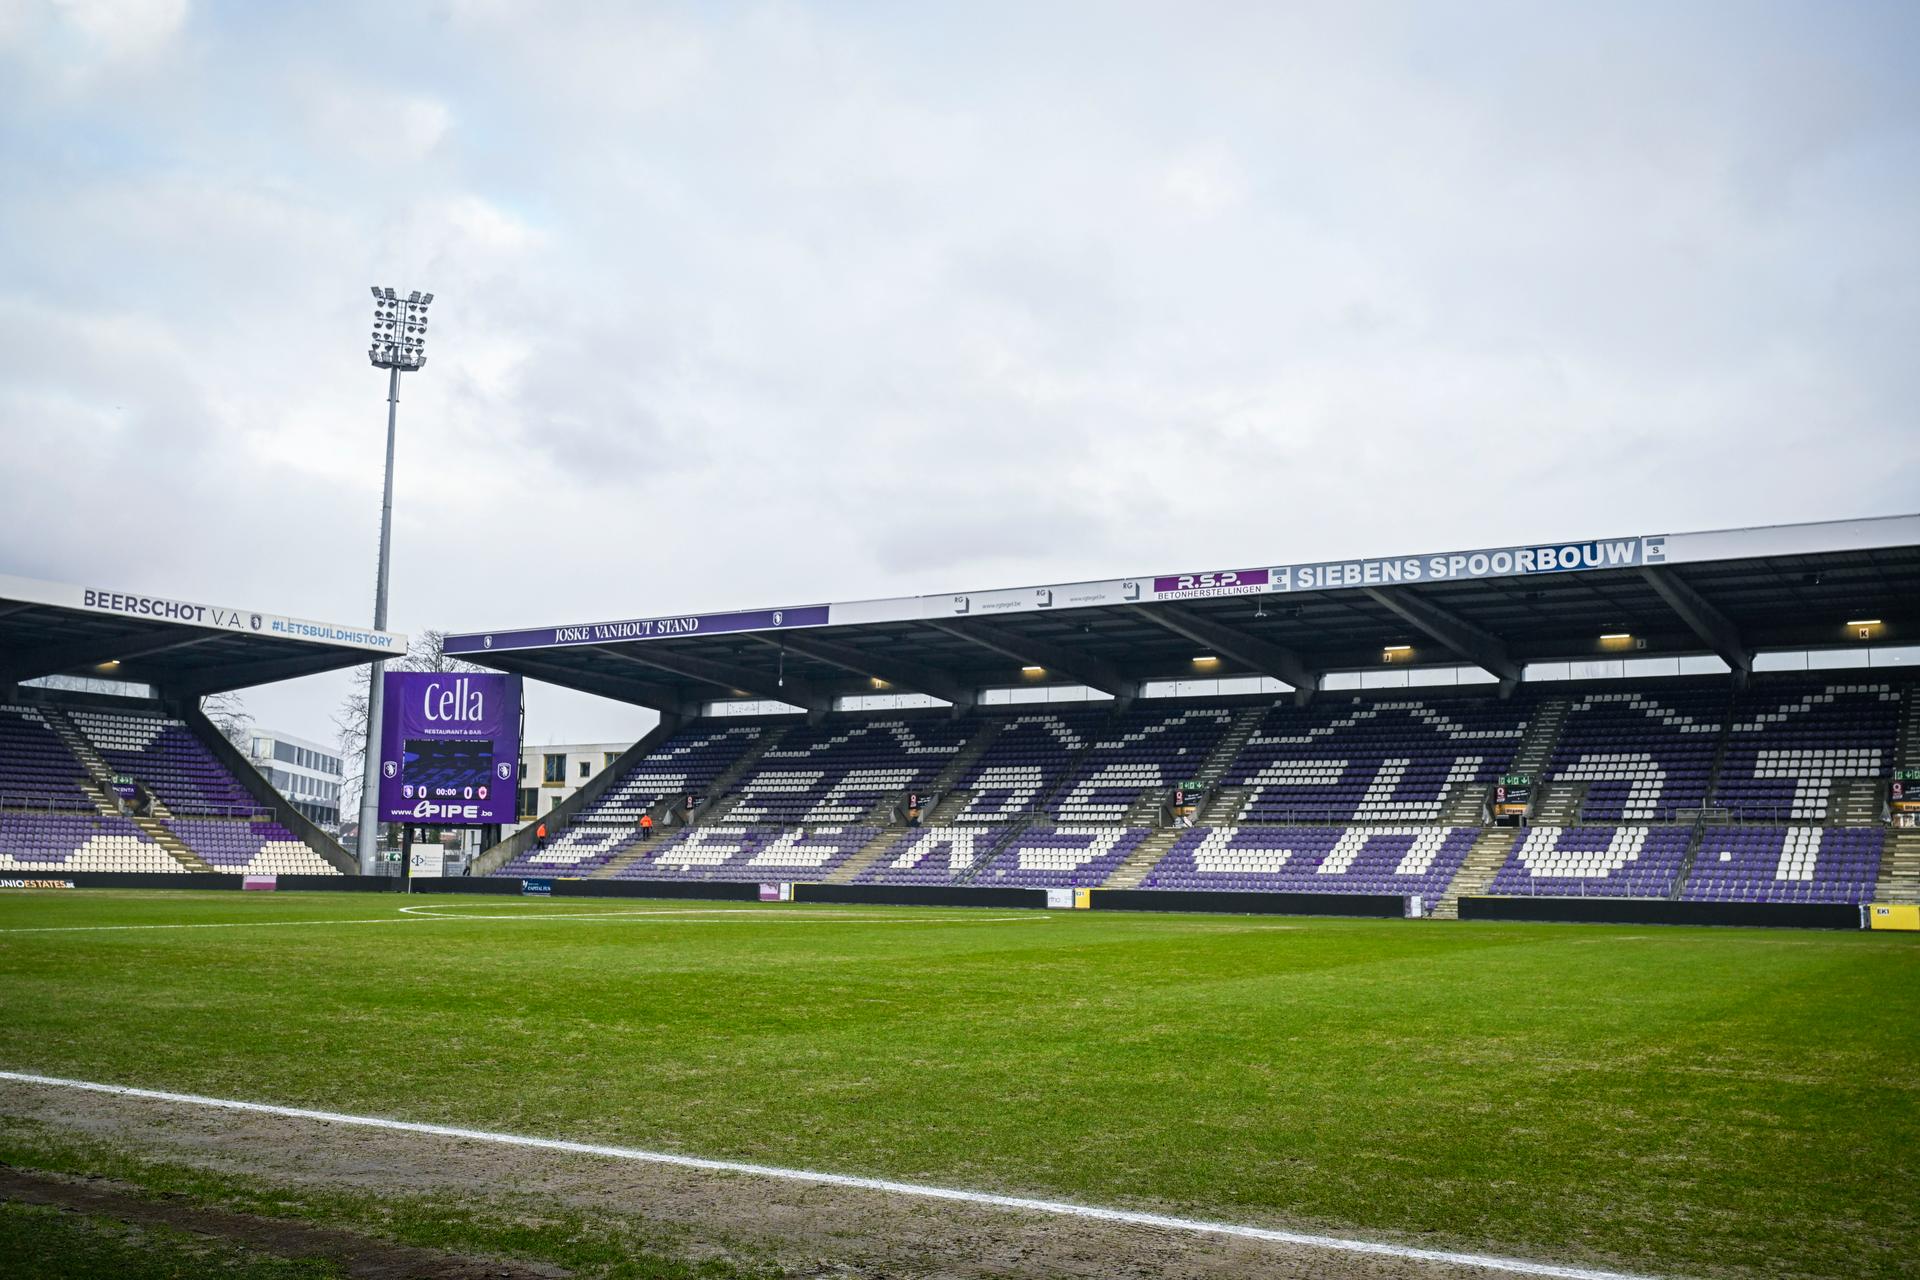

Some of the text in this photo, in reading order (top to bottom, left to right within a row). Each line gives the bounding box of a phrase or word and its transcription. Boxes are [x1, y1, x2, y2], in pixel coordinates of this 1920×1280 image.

[1297, 541, 1636, 588] SIEBENS SPOORBOUW
[1158, 585, 1262, 600] BETONHERSTELLINGEN
[1177, 572, 1241, 590] R.S.P.
[84, 589, 206, 622] BEERSCHOT
[272, 620, 393, 647] #LETSBUILDHISTORY
[555, 617, 699, 644] JOSKE VANHOUT STAND
[424, 677, 483, 721] Cella
[418, 786, 473, 800] 0 00:00 0
